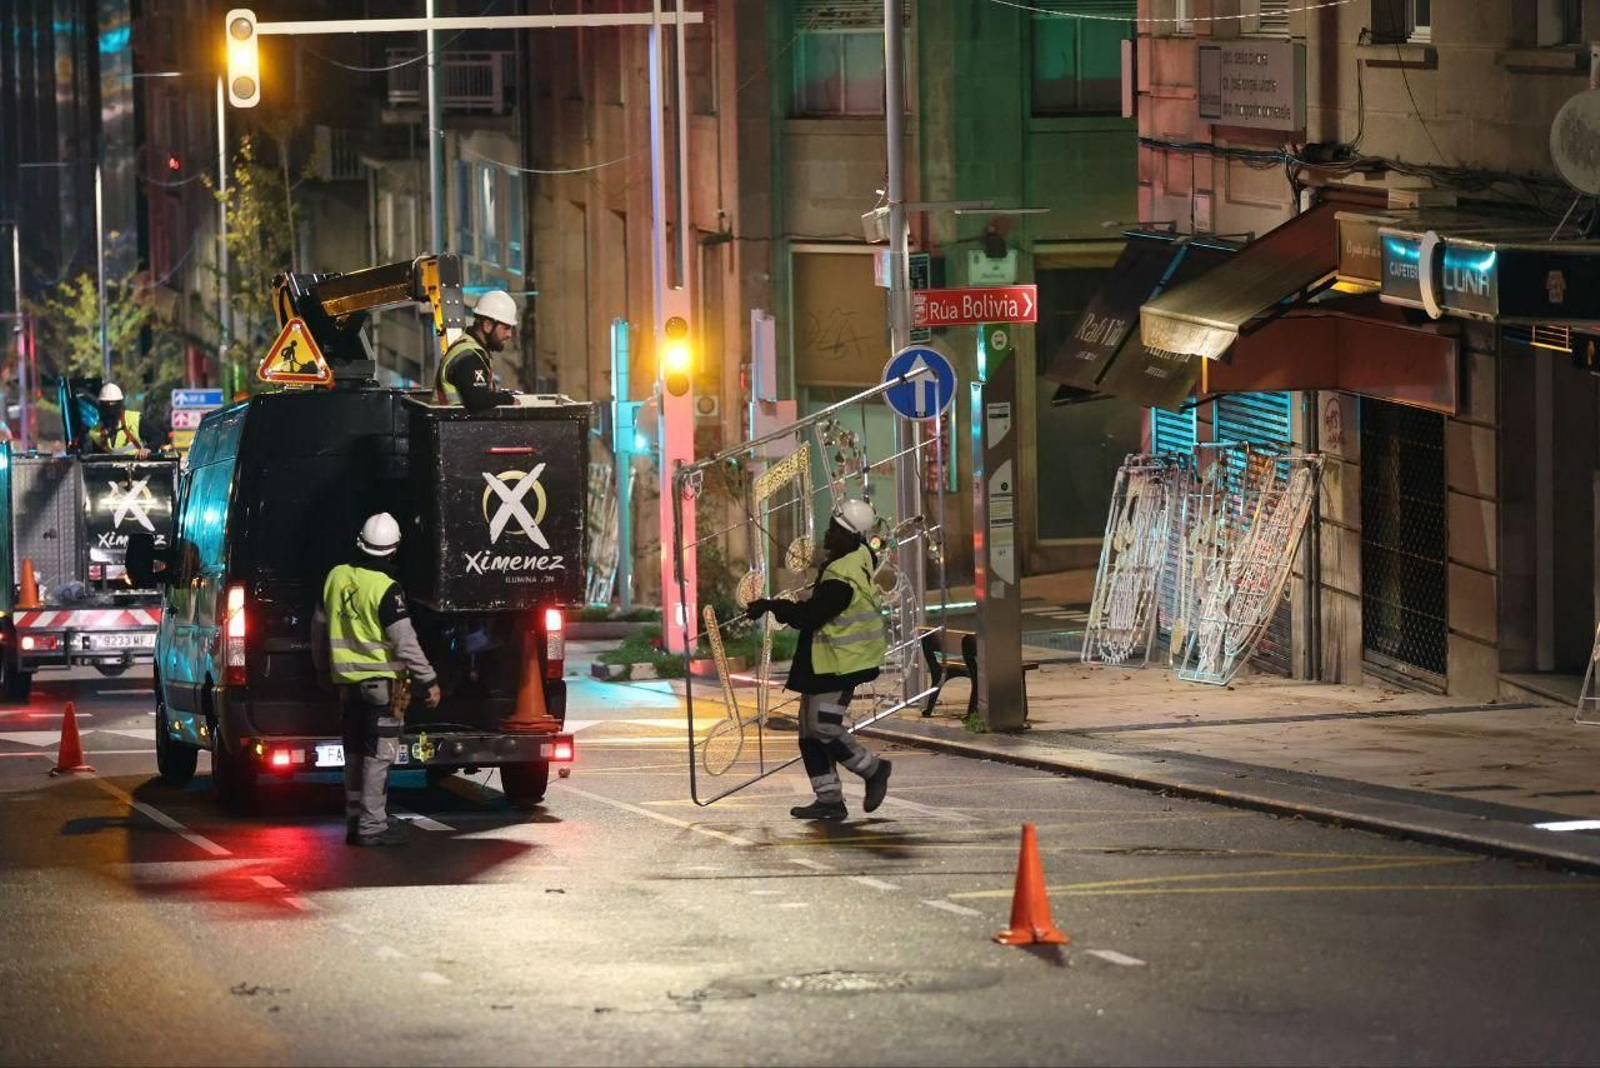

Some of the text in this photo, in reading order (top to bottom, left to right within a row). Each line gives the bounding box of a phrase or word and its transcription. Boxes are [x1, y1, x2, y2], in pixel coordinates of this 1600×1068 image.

[1389, 261, 1420, 280] CAFETER
[930, 294, 1018, 320] Rúa Bolivia
[96, 530, 168, 549] Ximz
[464, 549, 566, 575] Ximenez
